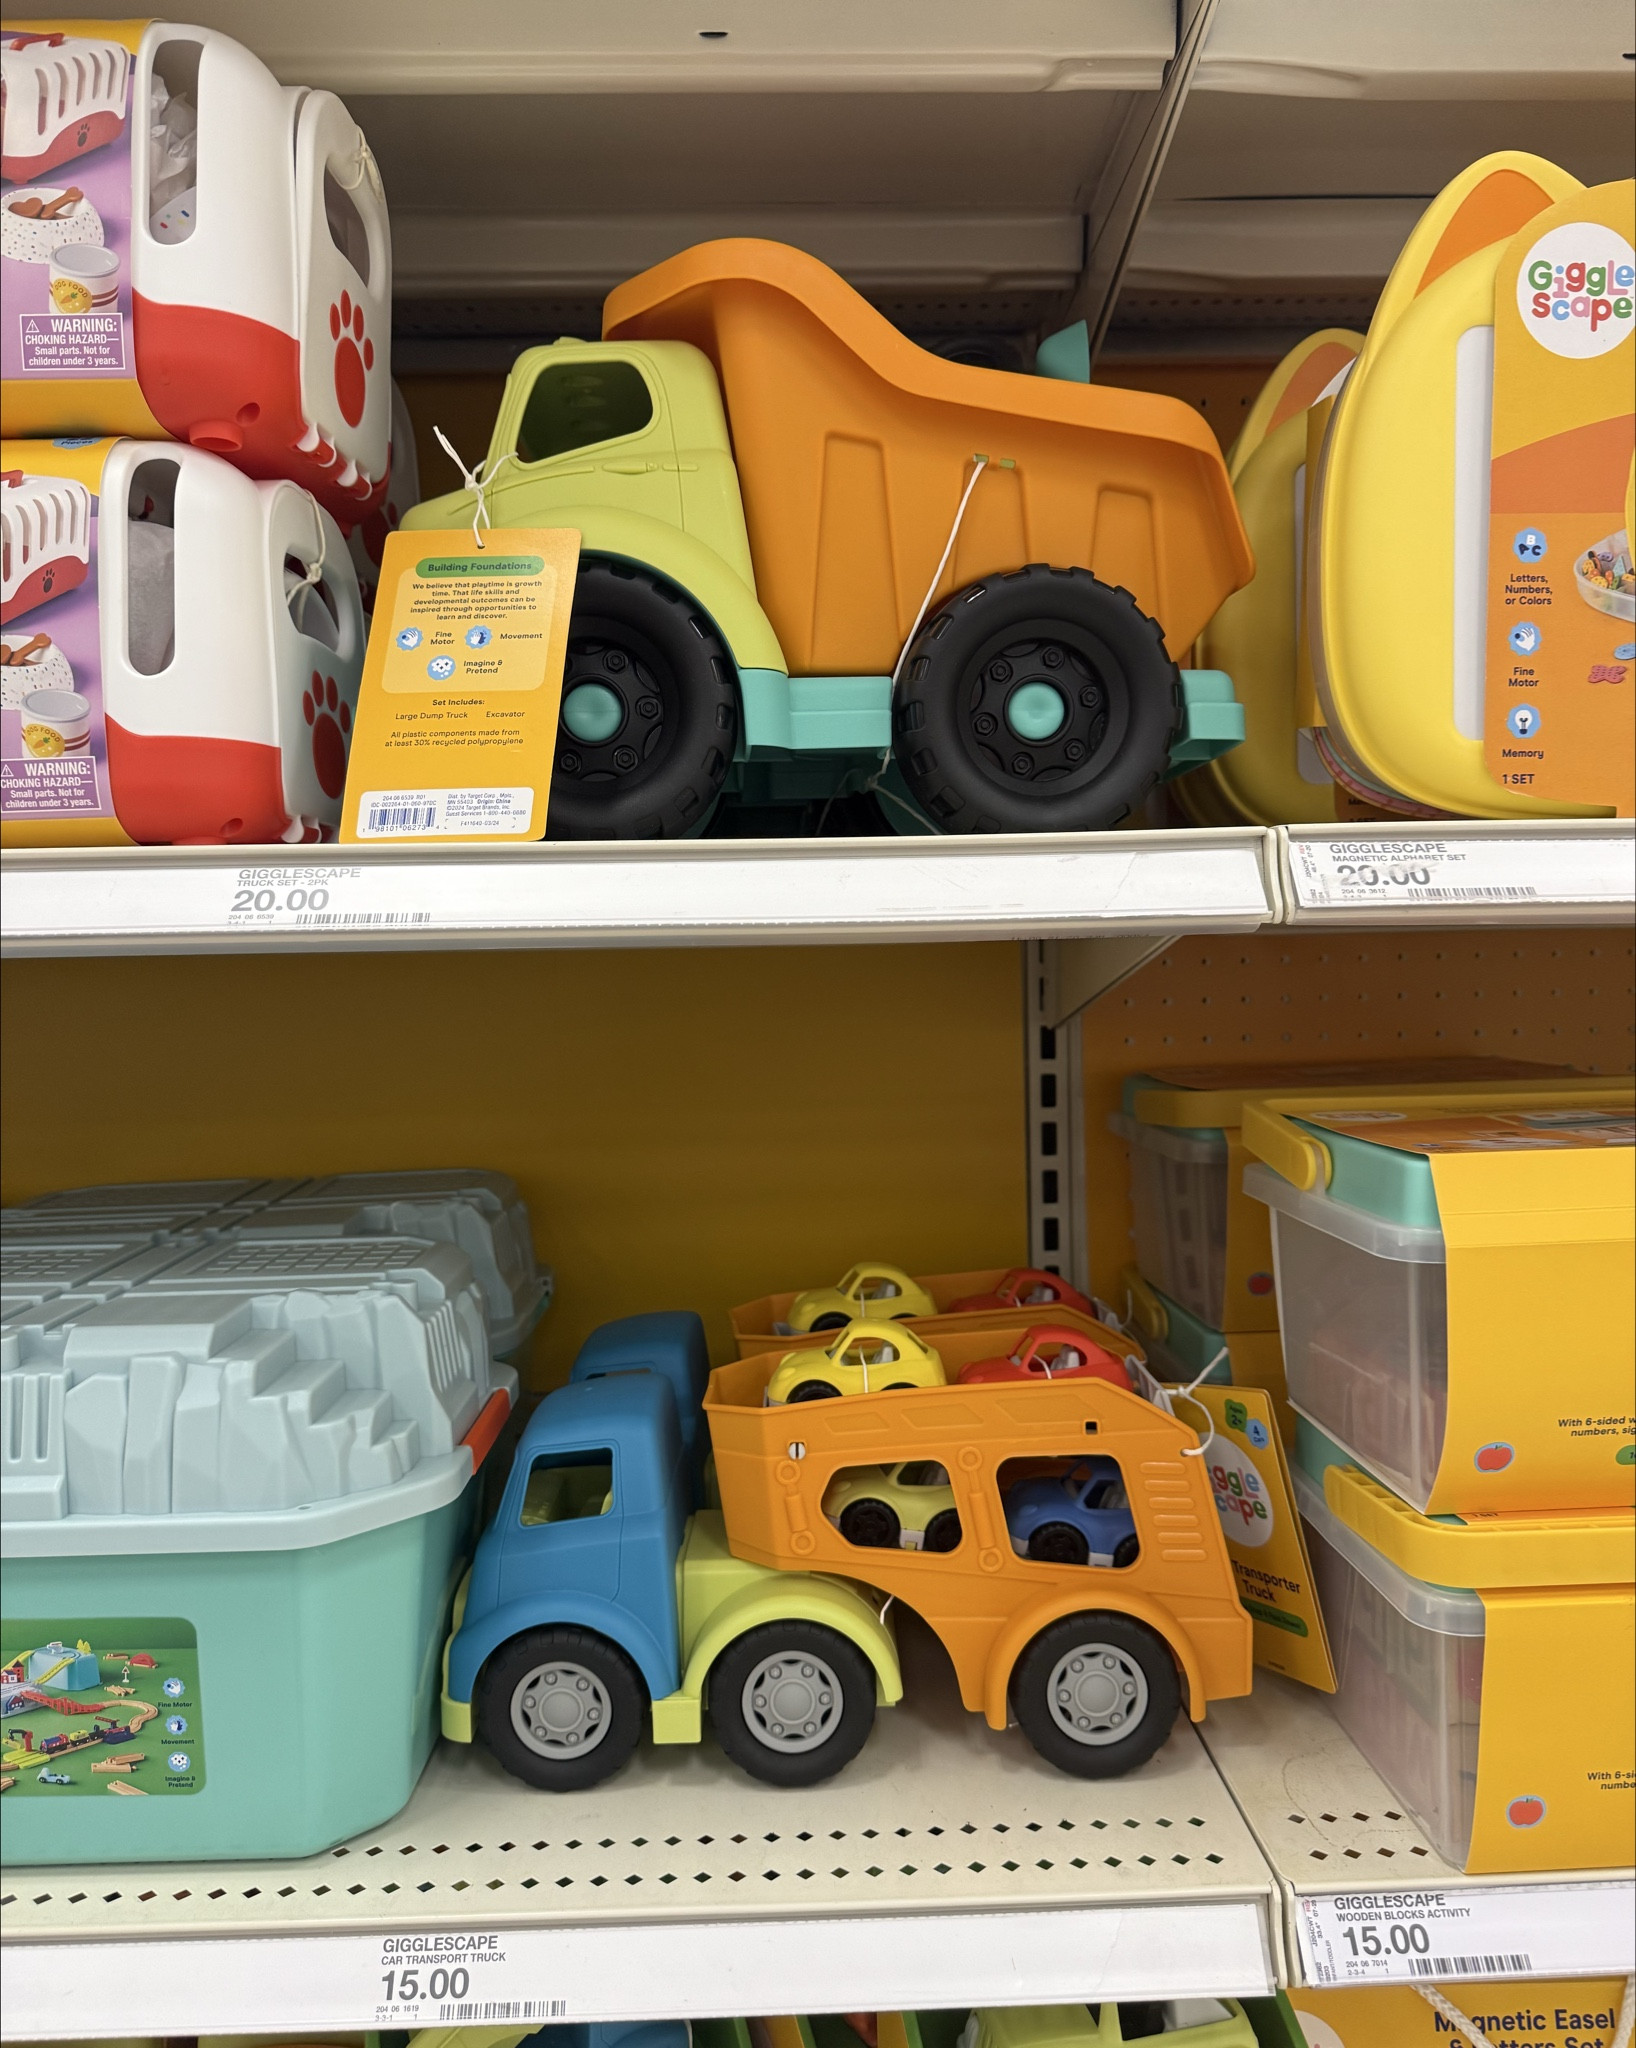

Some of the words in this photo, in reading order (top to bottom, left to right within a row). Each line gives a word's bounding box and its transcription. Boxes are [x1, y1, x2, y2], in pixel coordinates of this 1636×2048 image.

[68, 282, 88, 298] FOOD
[51, 318, 118, 333] WARNING:
[25, 334, 66, 345] CHOKING
[35, 346, 57, 356] Small
[59, 346, 82, 357] parts.
[83, 346, 97, 355] Not
[99, 345, 111, 355] for
[29, 357, 61, 366] children
[63, 357, 86, 365] under
[87, 356, 93, 365] 3
[94, 357, 119, 367] years.
[428, 563, 468, 572] Building
[471, 562, 532, 570] Foundations
[1510, 573, 1548, 584] Letters,
[1505, 584, 1553, 595] Numbers,
[1505, 597, 1516, 605] or
[1519, 595, 1552, 605] Colors
[410, 606, 441, 614] inspired
[1513, 667, 1535, 676] Fine
[1508, 678, 1539, 687] Motor
[395, 713, 418, 721] Large
[419, 712, 444, 720] Dump
[40, 727, 61, 743] FOOD
[402, 731, 427, 739] plastic
[429, 730, 477, 738] components
[467, 738, 524, 746] polypropylene
[1502, 749, 1544, 759] Memory
[24, 761, 91, 777] WARNING:
[0, 779, 40, 789] CHOKING
[1502, 774, 1509, 784] 1
[1511, 773, 1535, 784] SET
[10, 789, 33, 799] Small
[34, 789, 57, 799] parts.
[58, 789, 72, 797] Not
[73, 788, 85, 796] for
[5, 800, 37, 808] children
[39, 799, 61, 807] under
[63, 799, 69, 807] 3
[69, 799, 94, 808] years.
[1330, 843, 1448, 854] GIGGLESCAPE
[239, 868, 362, 879] GIGGLESCAPE
[237, 879, 275, 887] TRUCK
[231, 889, 329, 911] 20.00
[1558, 1419, 1582, 1427] With
[1585, 1416, 1626, 1426] 6-sided
[1253, 1425, 1260, 1436] 4
[1571, 1428, 1619, 1437] numbers,
[1214, 1494, 1268, 1526] cape
[1232, 1559, 1301, 1593] Transporter
[1242, 1579, 1277, 1603] Truck
[1587, 1772, 1611, 1780] With
[1615, 1770, 1636, 1779] 6-si
[1334, 1894, 1446, 1910] GIGGLESCAPE
[1336, 1911, 1382, 1922] WOODEN
[1384, 1909, 1425, 1920] BLOCKS
[1427, 1908, 1471, 1919] ACTIVITY
[383, 1935, 498, 1953] GIGGLESCAPE
[1342, 1924, 1430, 1956] 15.00
[381, 1955, 403, 1966] CAR
[406, 1953, 468, 1965] TRANSPORT
[470, 1952, 506, 1963] TRUCK
[381, 1967, 470, 2001] 15.00
[403, 2004, 419, 2012] 1619
[1434, 2008, 1546, 2035] Mgnetic
[1554, 2008, 1616, 2030] Easel
